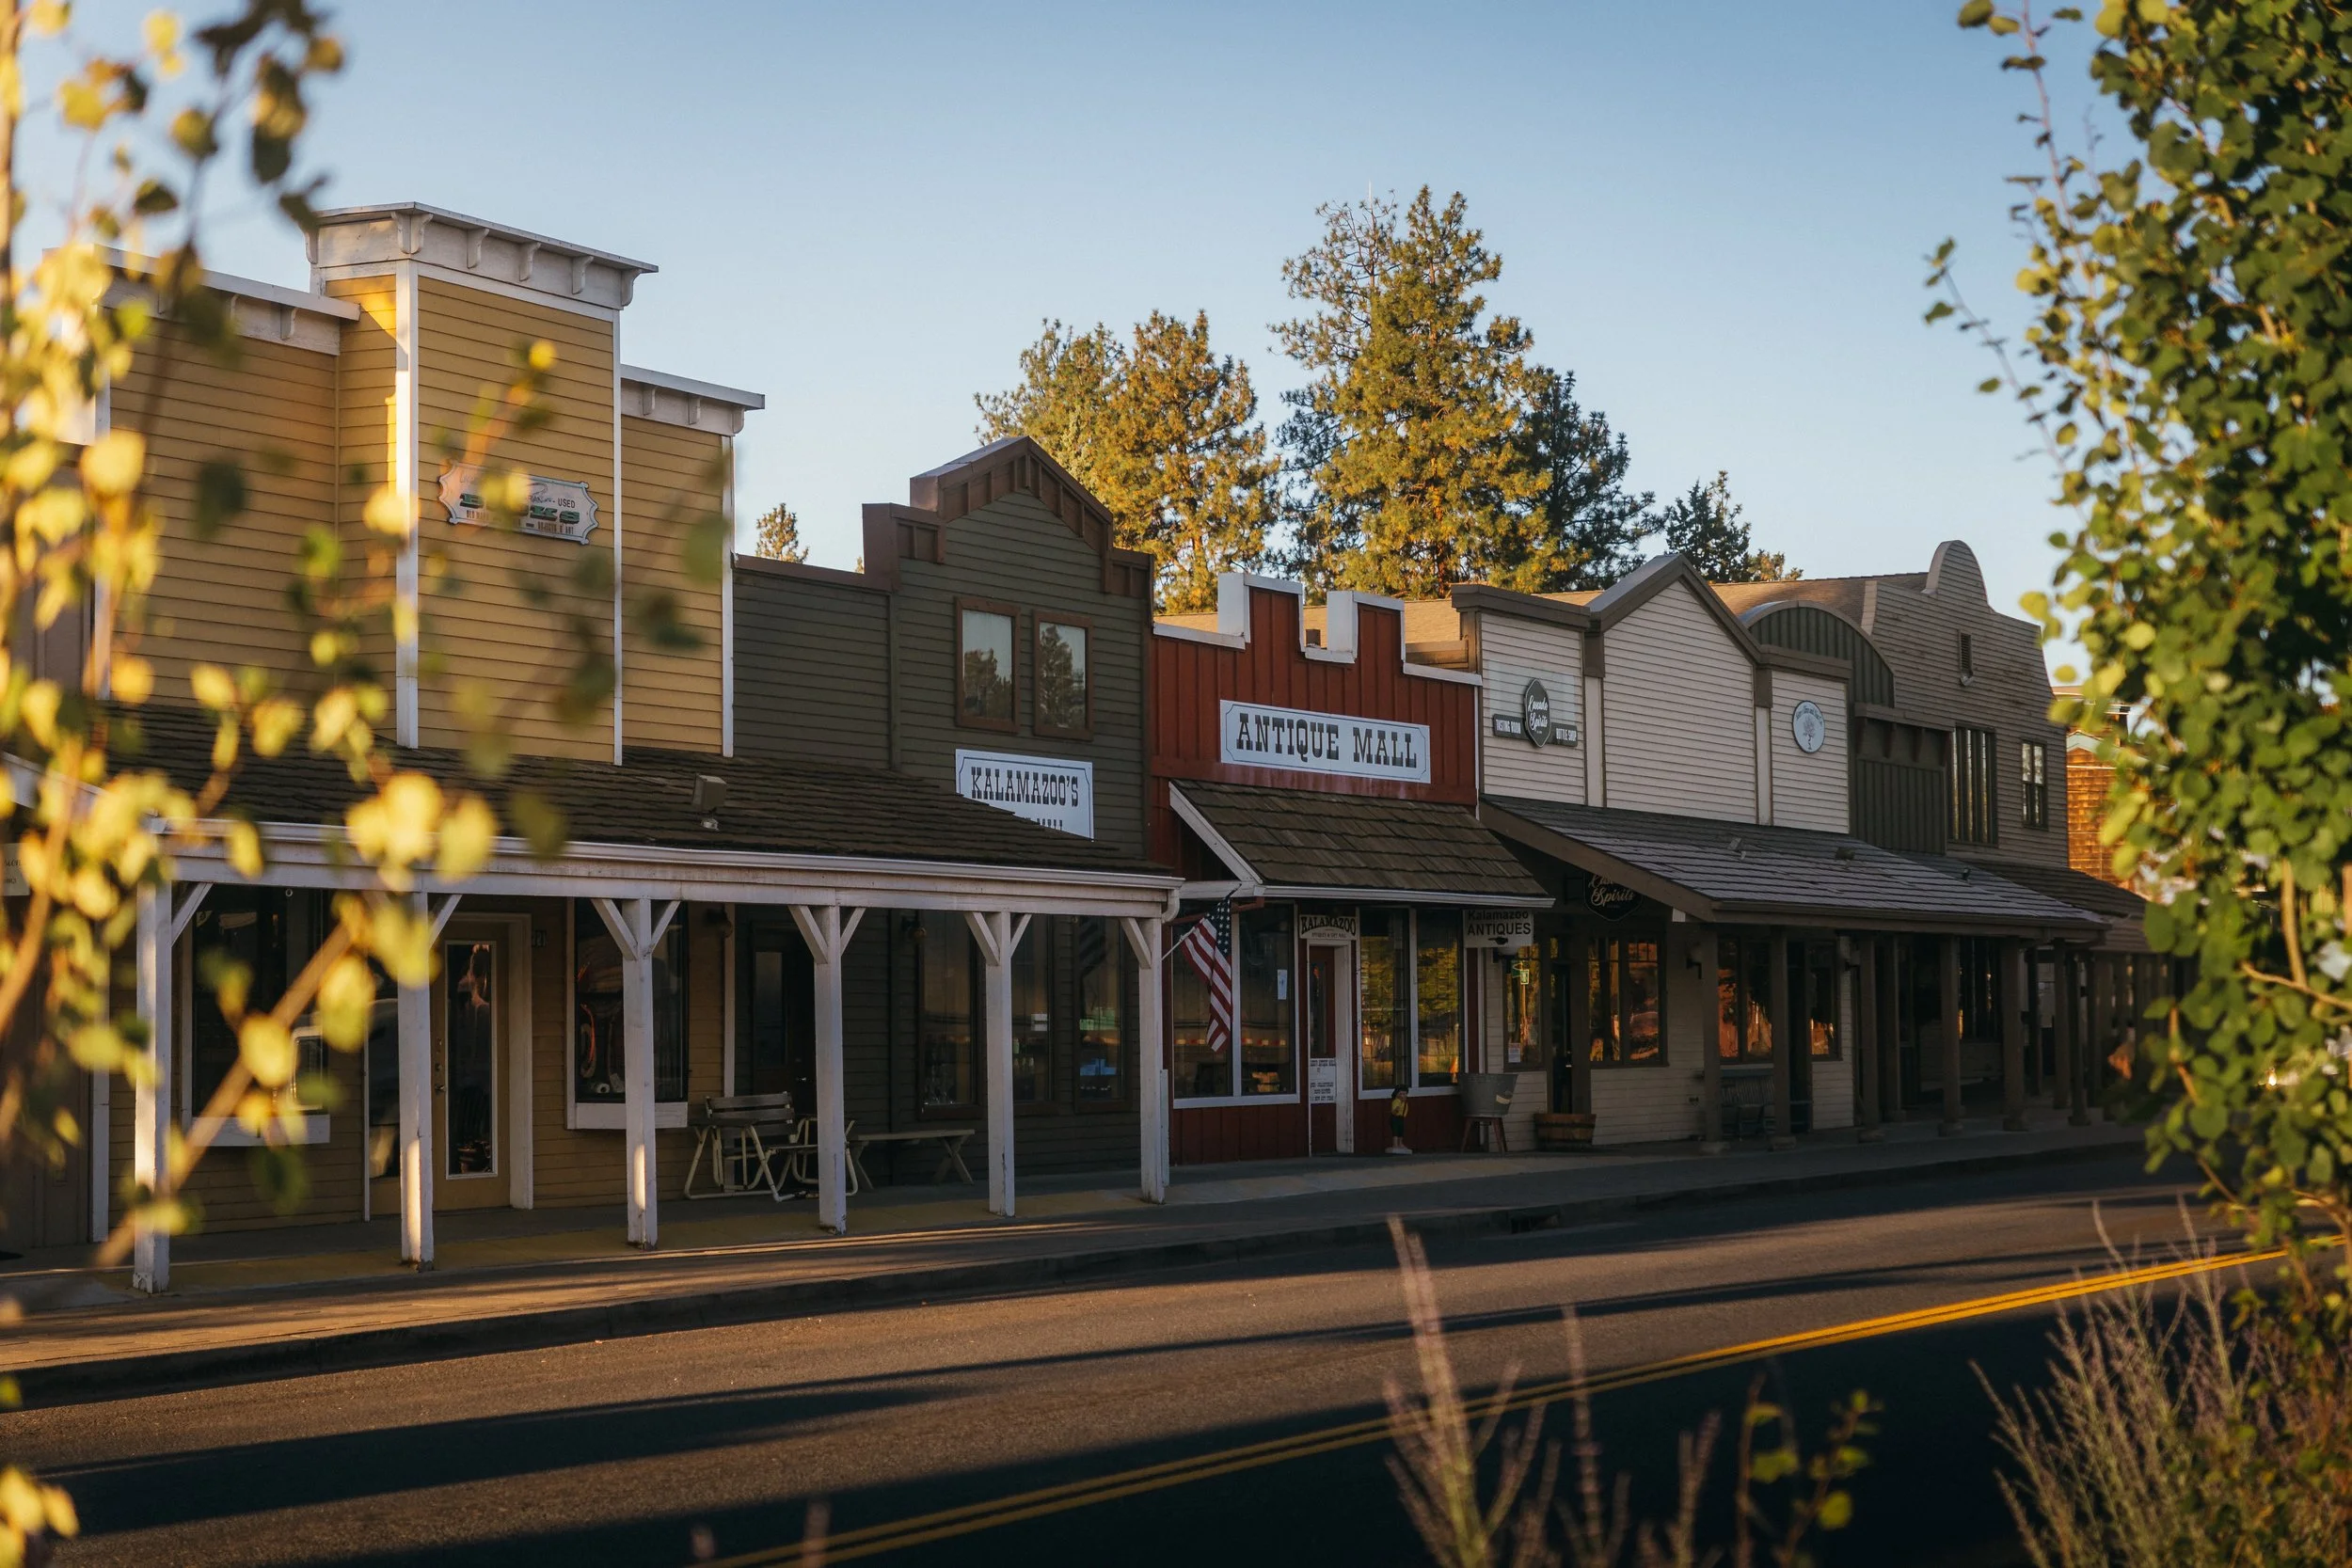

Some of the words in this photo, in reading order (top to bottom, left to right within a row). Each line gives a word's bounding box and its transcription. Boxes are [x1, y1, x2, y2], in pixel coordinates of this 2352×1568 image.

[459, 492, 580, 525] BKS
[557, 497, 576, 510] USED
[1530, 712, 1548, 731] Spirits
[1235, 712, 1340, 763] ANTIQUE
[1352, 726, 1418, 768] MALL
[1568, 730, 1577, 742] SHOP
[971, 766, 1079, 808] KALAMAZOO'S
[1591, 887, 1634, 908] Spirits
[1468, 910, 1529, 921] Kalamazoo
[1300, 916, 1357, 937] KALAMAZOO
[1467, 922, 1532, 937] ANTIQUES
